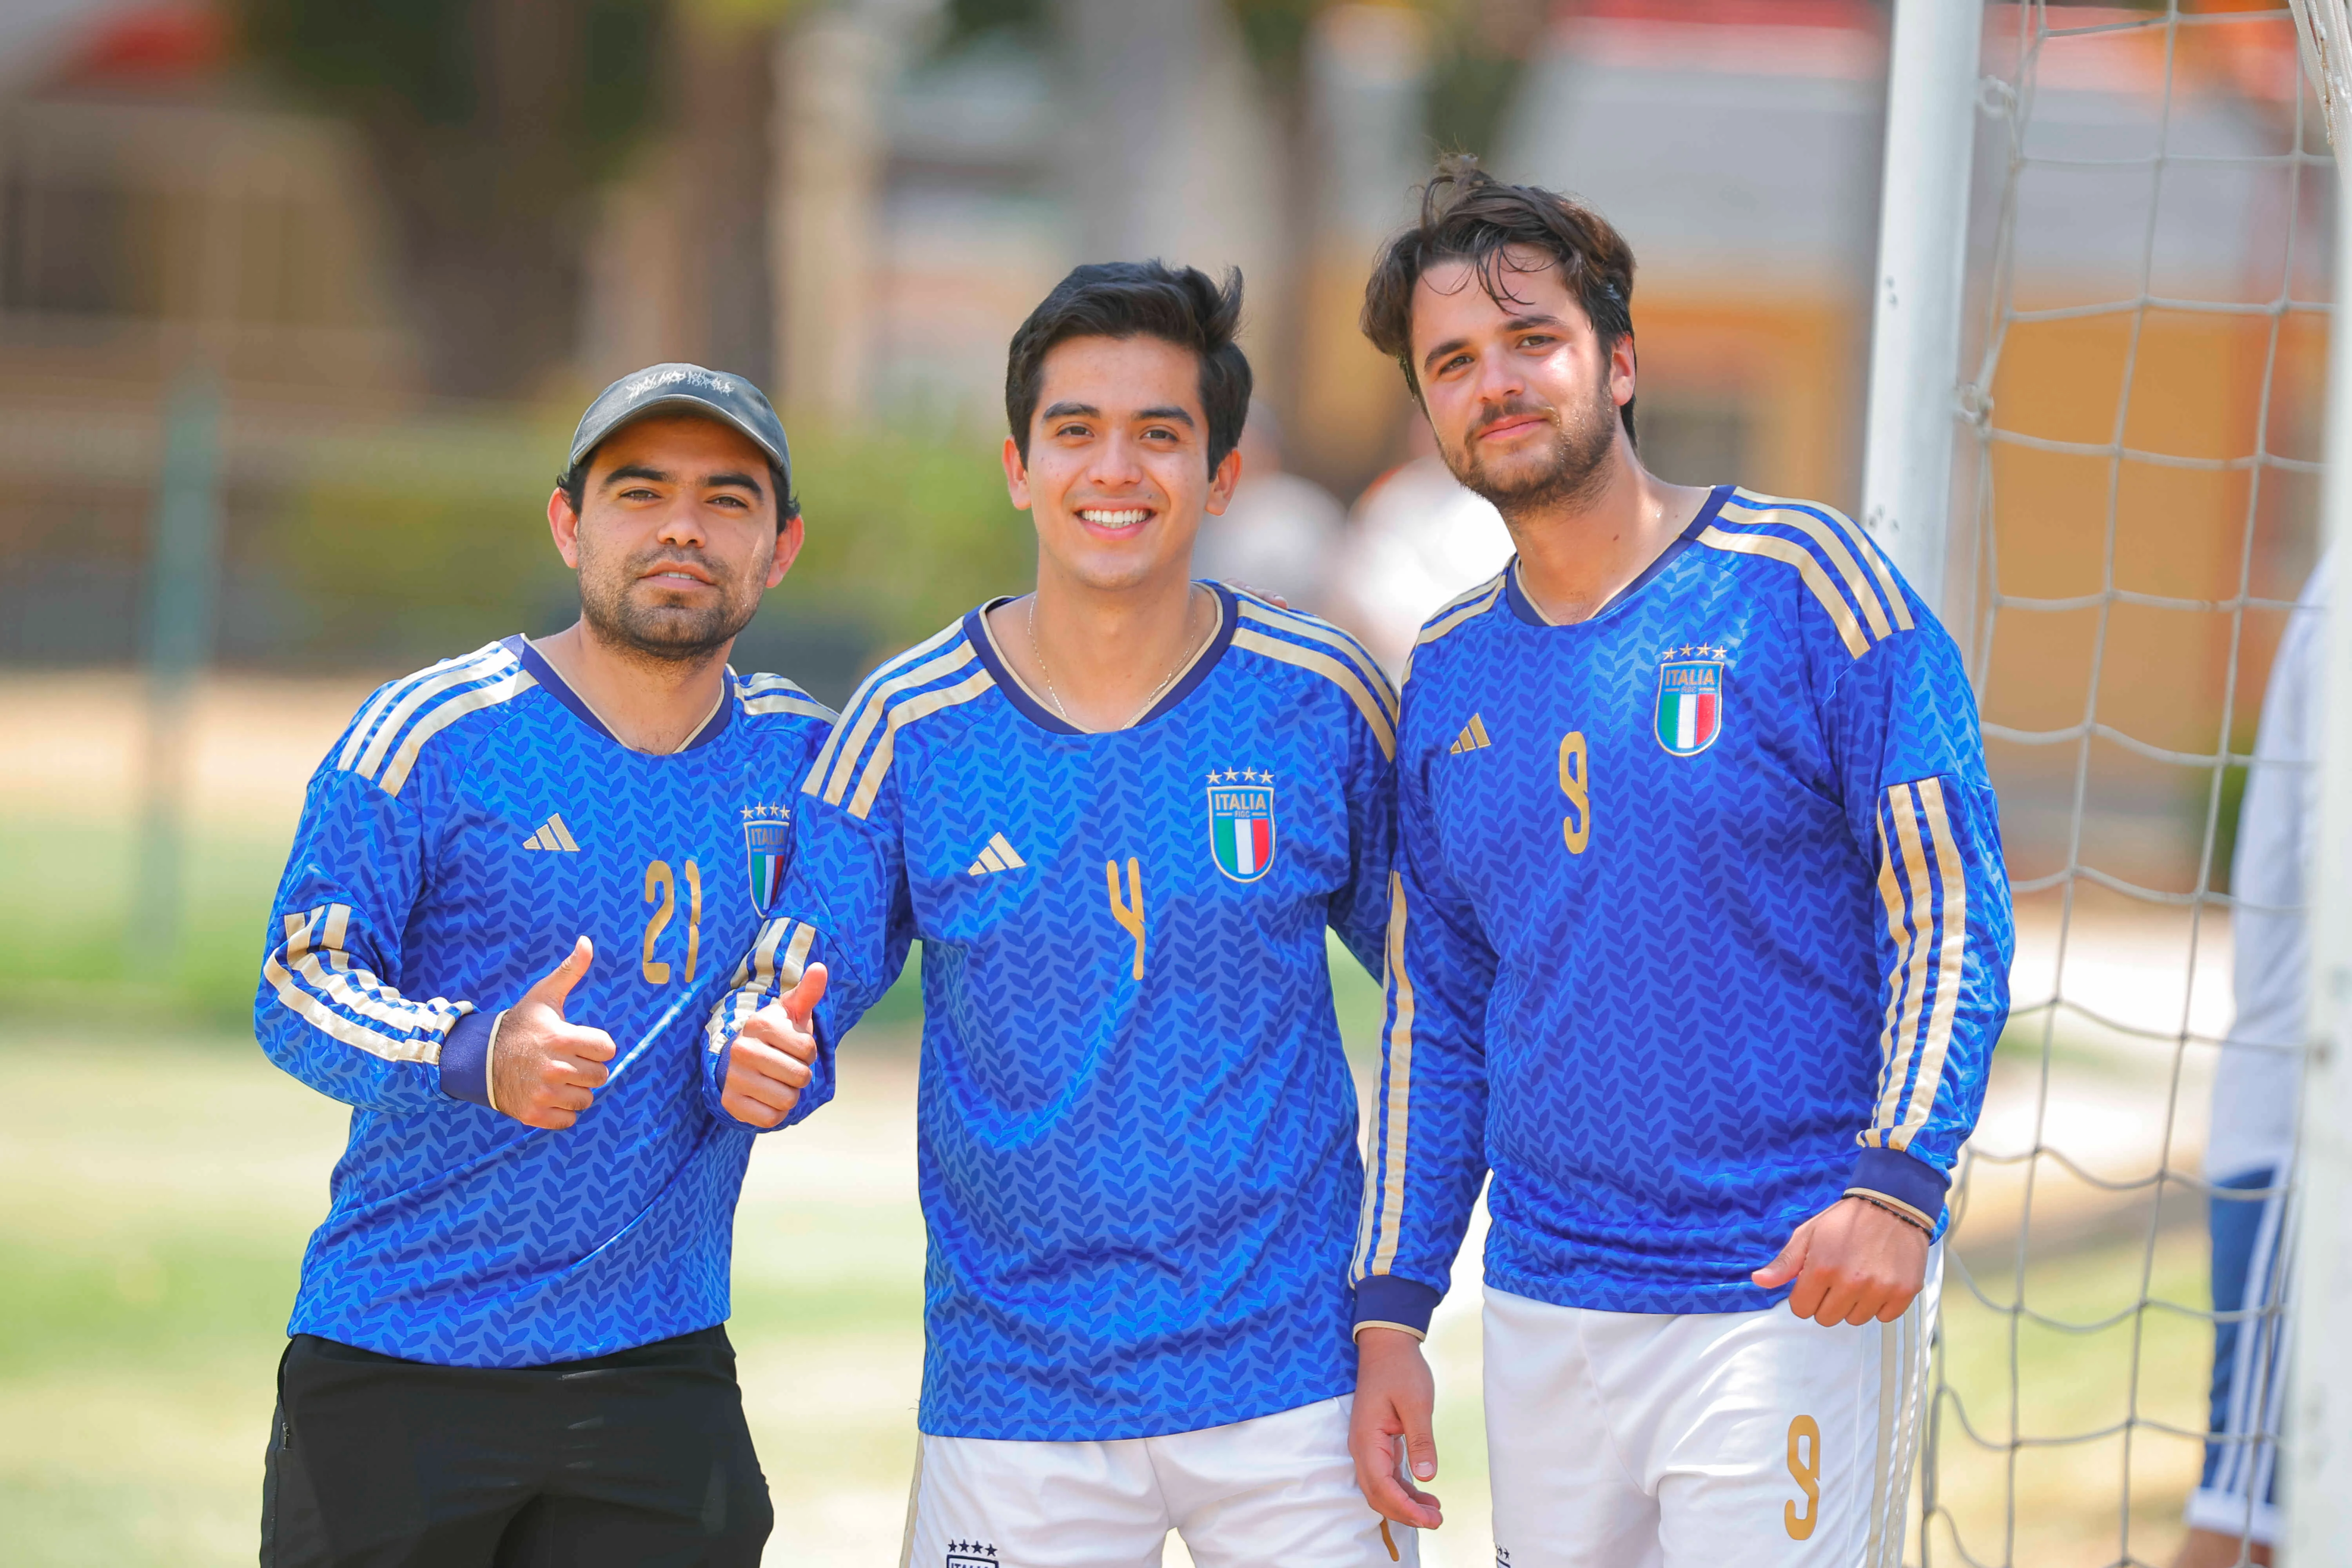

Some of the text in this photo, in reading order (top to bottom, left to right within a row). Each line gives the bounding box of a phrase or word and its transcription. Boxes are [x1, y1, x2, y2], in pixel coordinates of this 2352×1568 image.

[1666, 669, 1715, 685] ITALIA
[751, 828, 784, 846] ITALIA
[1216, 793, 1267, 810] ITALIA
[1559, 731, 1590, 854] 9
[642, 859, 702, 984] 21
[1107, 857, 1145, 980] 4
[1784, 1415, 1820, 1541] 9
